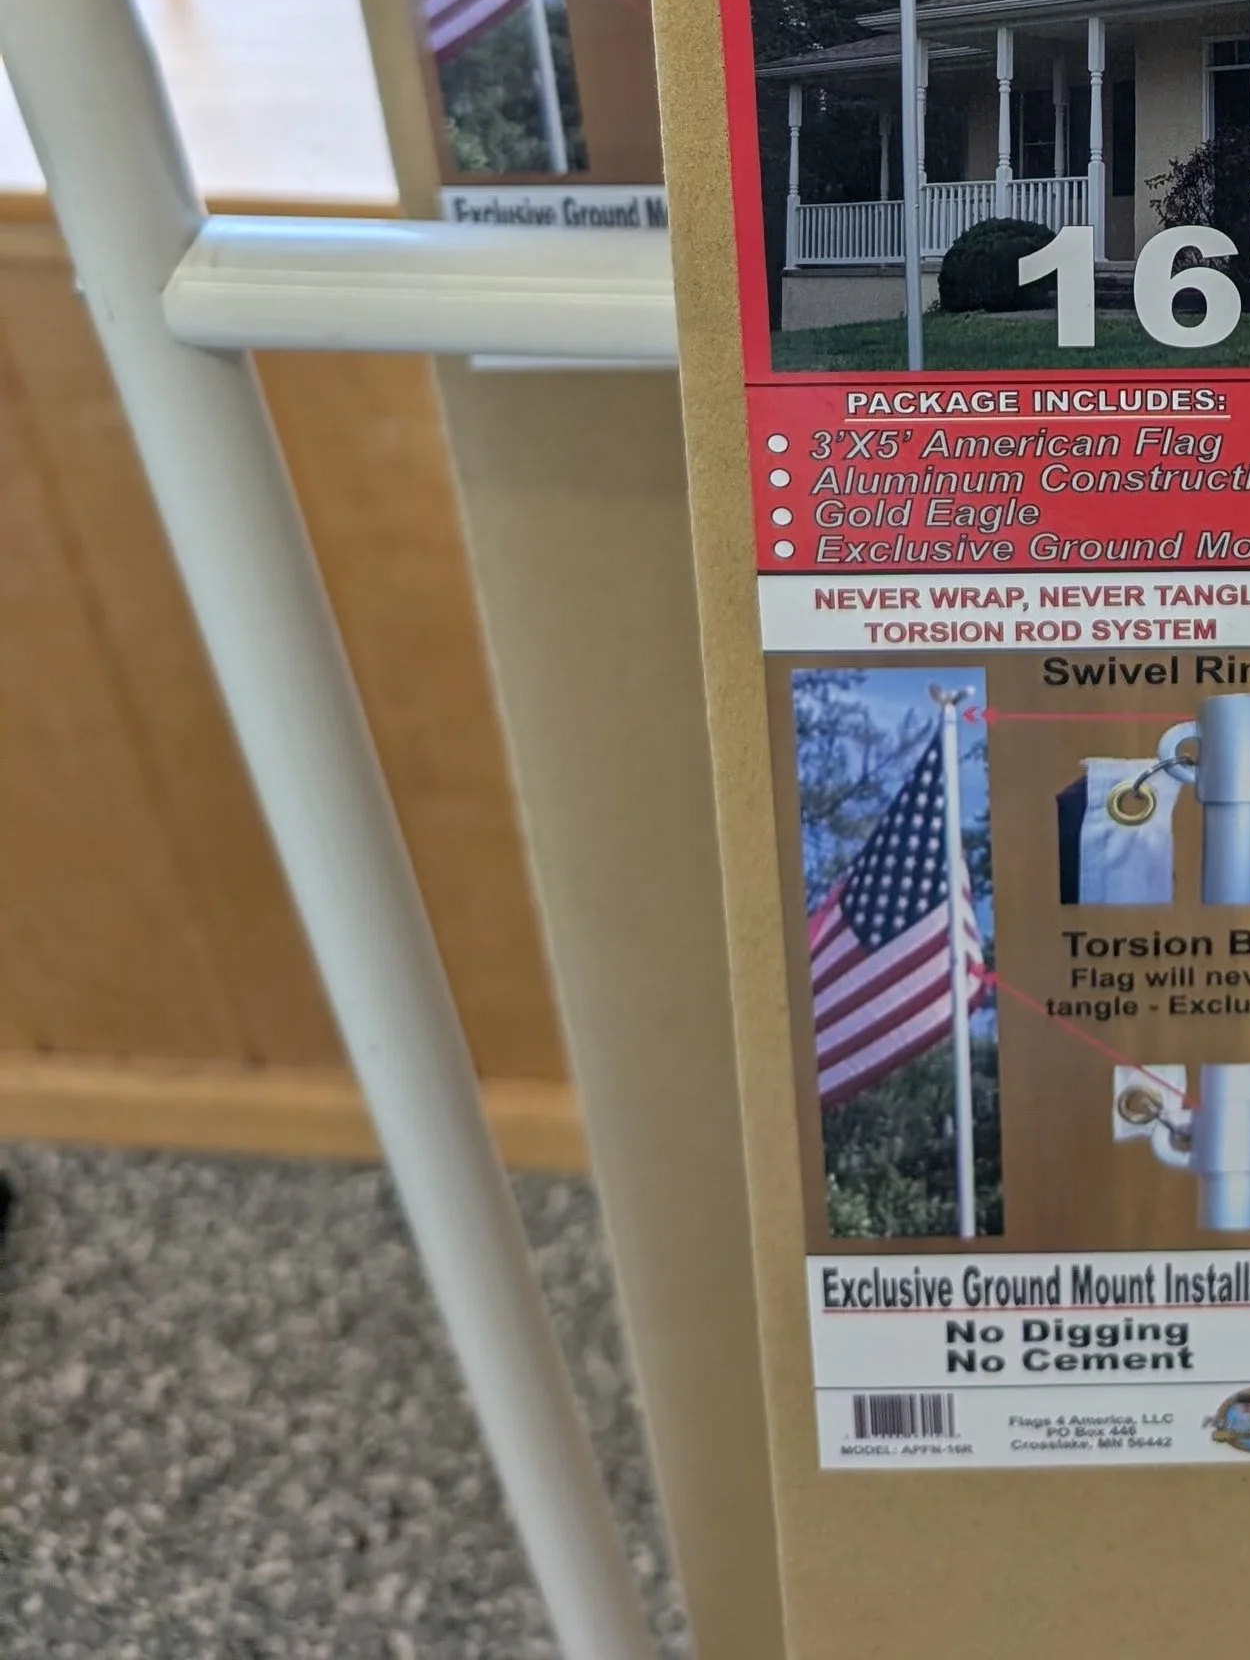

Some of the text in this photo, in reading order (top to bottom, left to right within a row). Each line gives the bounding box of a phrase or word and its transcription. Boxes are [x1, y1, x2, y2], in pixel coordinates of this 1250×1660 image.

[847, 389, 1228, 415] PACKAGE INCLUDES:
[921, 429, 1121, 459] American
[1134, 427, 1223, 463] Flag
[811, 465, 1024, 496] Aluminum
[813, 498, 1040, 534] Gold Eagle
[815, 534, 1015, 564] Exclusive
[1029, 531, 1183, 562] Ground
[814, 587, 920, 610] NEVER
[929, 586, 1030, 612] WRAP,
[1039, 584, 1145, 608] NEVER
[863, 618, 1218, 643] TORSION ROD SYSTEM
[1042, 656, 1180, 687] Swivel
[1062, 930, 1213, 958] Torsion
[1070, 967, 1136, 993] Flag
[1145, 967, 1197, 988] will
[1046, 995, 1138, 1022] tangle
[823, 1266, 953, 1308] Exclusive
[961, 1265, 1061, 1307] Ground
[1071, 1263, 1155, 1306] Mount
[946, 1318, 1190, 1347] No Digging
[946, 1346, 1195, 1374] No Cement
[1008, 1415, 1051, 1428] Flags
[1056, 1415, 1066, 1426] 4
[1141, 1413, 1174, 1424] LLC
[1046, 1427, 1070, 1437] PO
[1075, 1426, 1105, 1437] Box
[840, 1445, 898, 1455] MODEL:
[1097, 1438, 1123, 1448] MN
